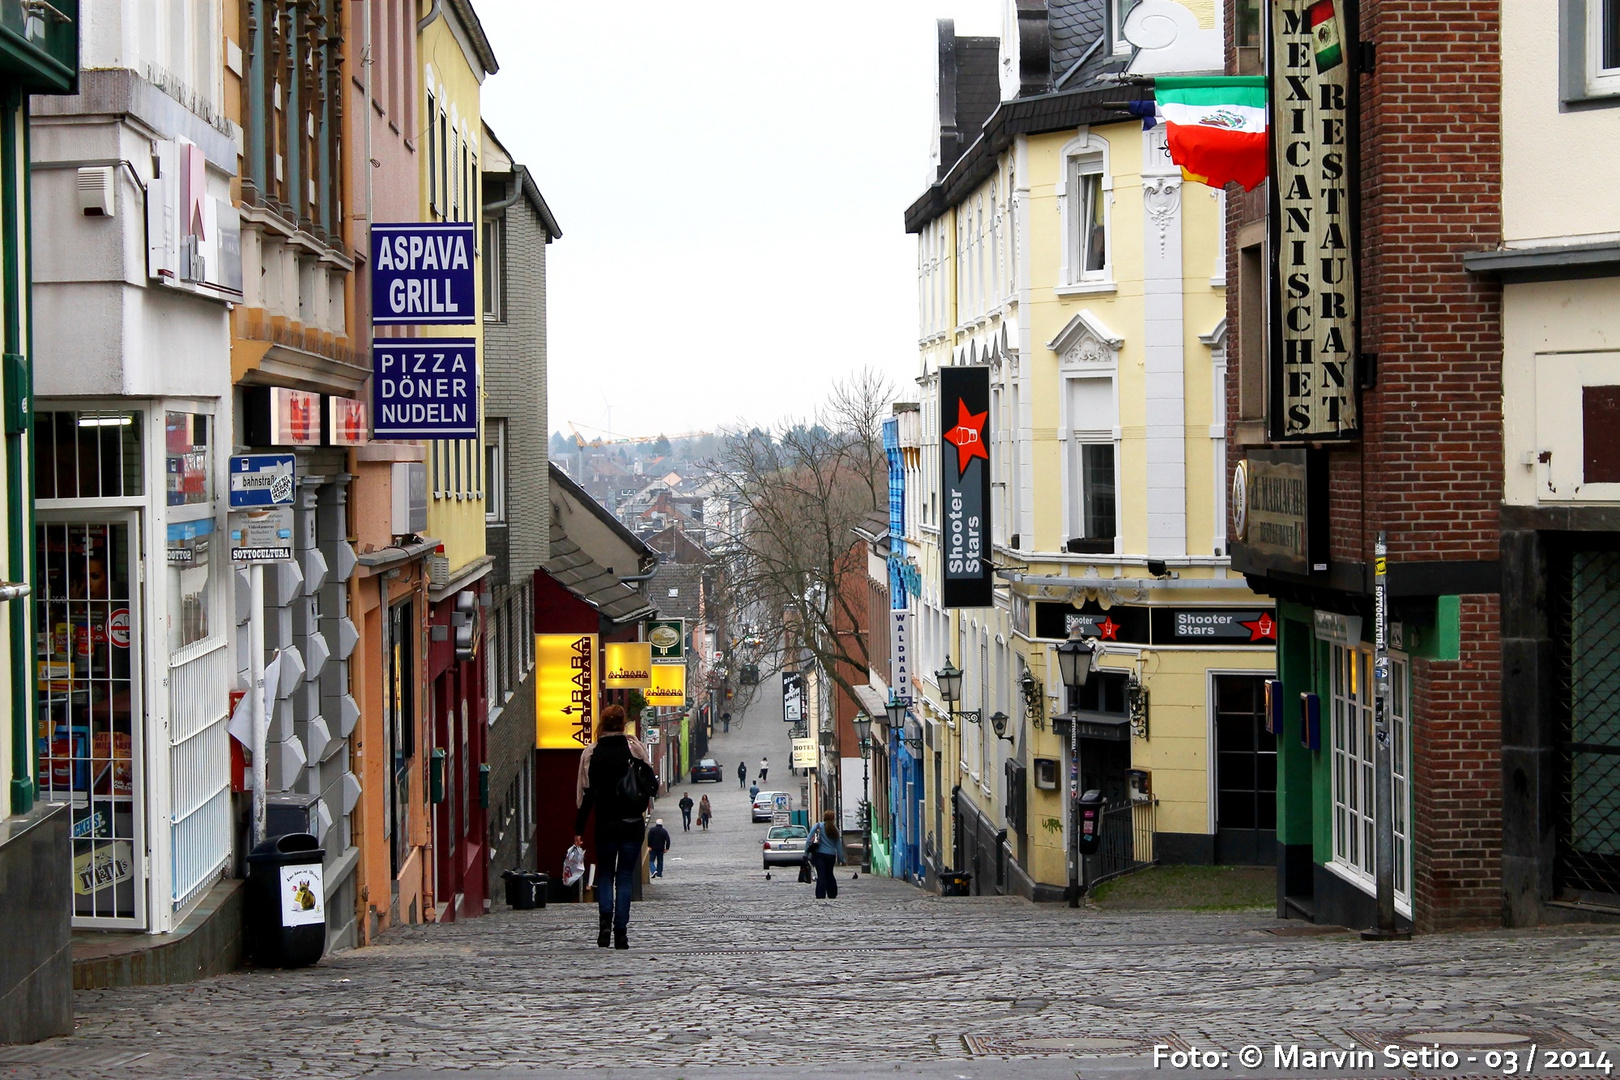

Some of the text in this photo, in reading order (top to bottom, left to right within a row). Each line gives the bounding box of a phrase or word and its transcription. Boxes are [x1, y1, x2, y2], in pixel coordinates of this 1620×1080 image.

[1283, 10, 1314, 432] MEXICANISCHES
[377, 235, 469, 270] ASPAVA
[1319, 84, 1347, 422] RESTAURANT
[389, 278, 458, 313] GRILL
[381, 354, 467, 373] PIZZA
[382, 375, 467, 398] DÖNER
[382, 404, 467, 423] NUDELN
[949, 488, 963, 573] Shooter
[965, 515, 980, 573] Stars
[233, 548, 290, 559] SOTTOCULTURA
[1178, 614, 1233, 625] Shooter
[1178, 625, 1215, 635] Stars
[1375, 586, 1384, 650] SOTTOCULTURA
[895, 614, 907, 695] WALDHAUS
[570, 637, 585, 746] ALIBABA
[583, 637, 591, 746] RESTAURANT
[785, 692, 800, 702] White
[793, 744, 815, 752] HOTEL
